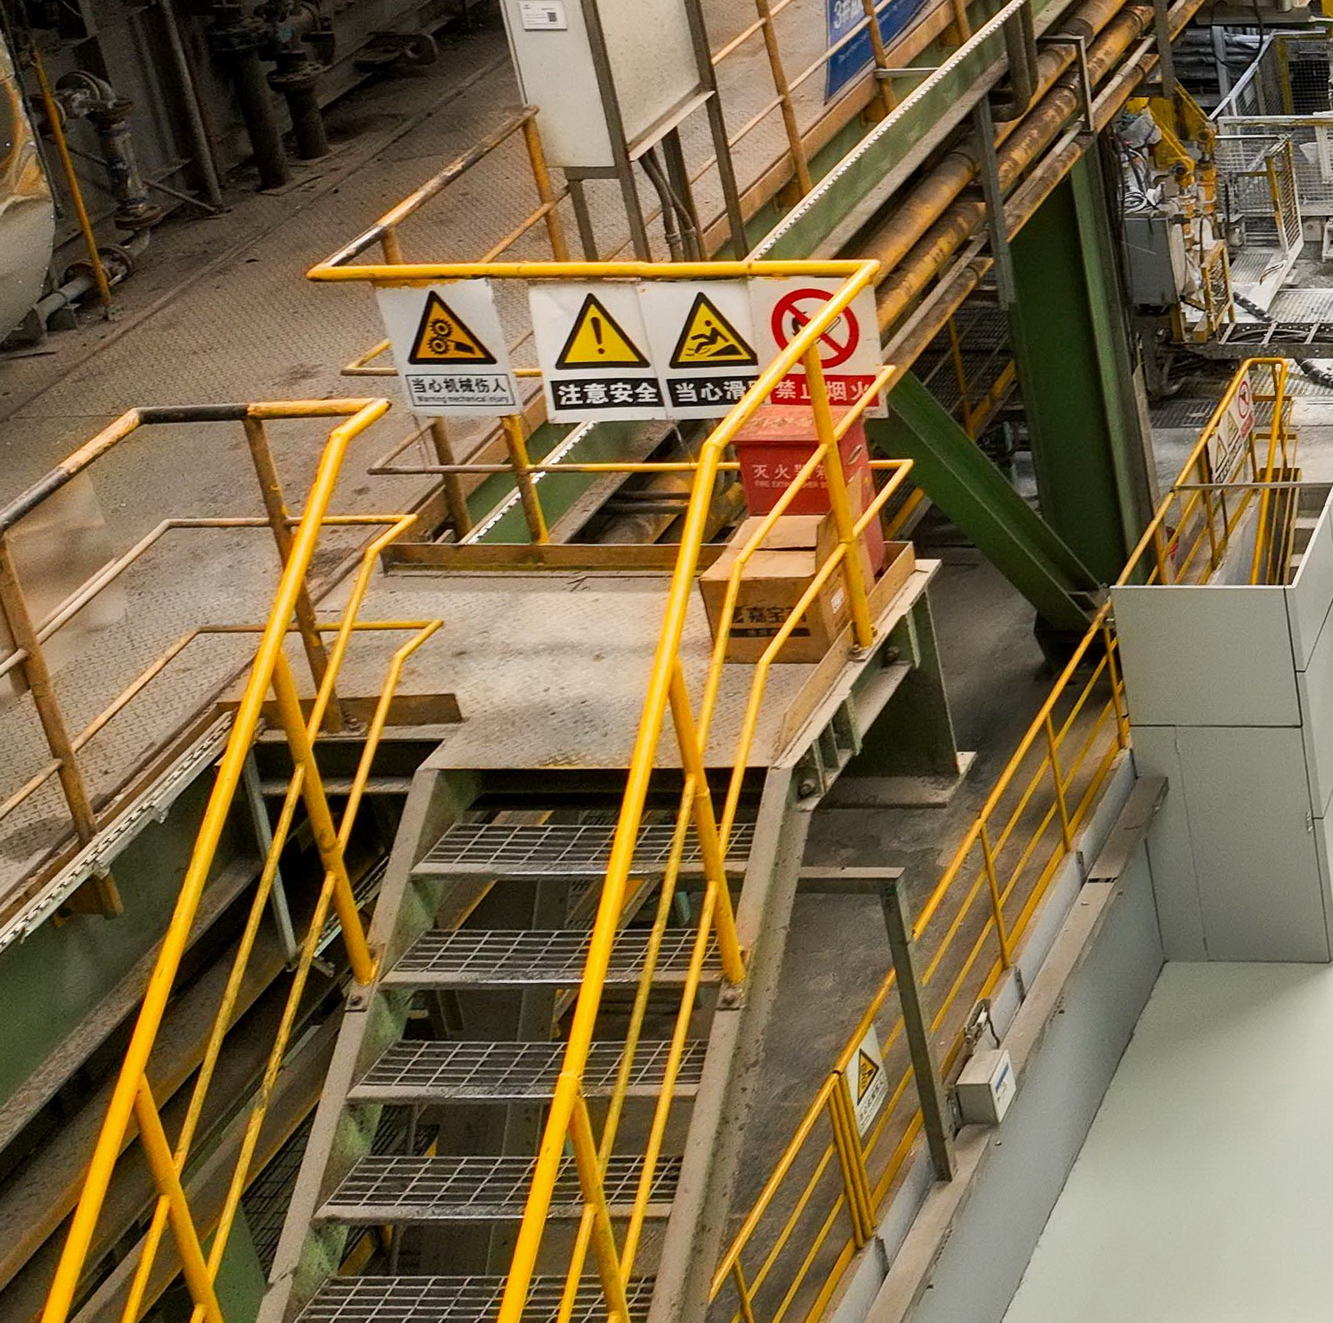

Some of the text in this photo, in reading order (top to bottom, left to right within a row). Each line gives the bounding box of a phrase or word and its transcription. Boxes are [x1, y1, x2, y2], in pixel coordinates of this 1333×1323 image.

[411, 378, 507, 393] 当心机械伤人
[557, 382, 659, 406] 注意安全
[675, 380, 756, 403] 当心滑
